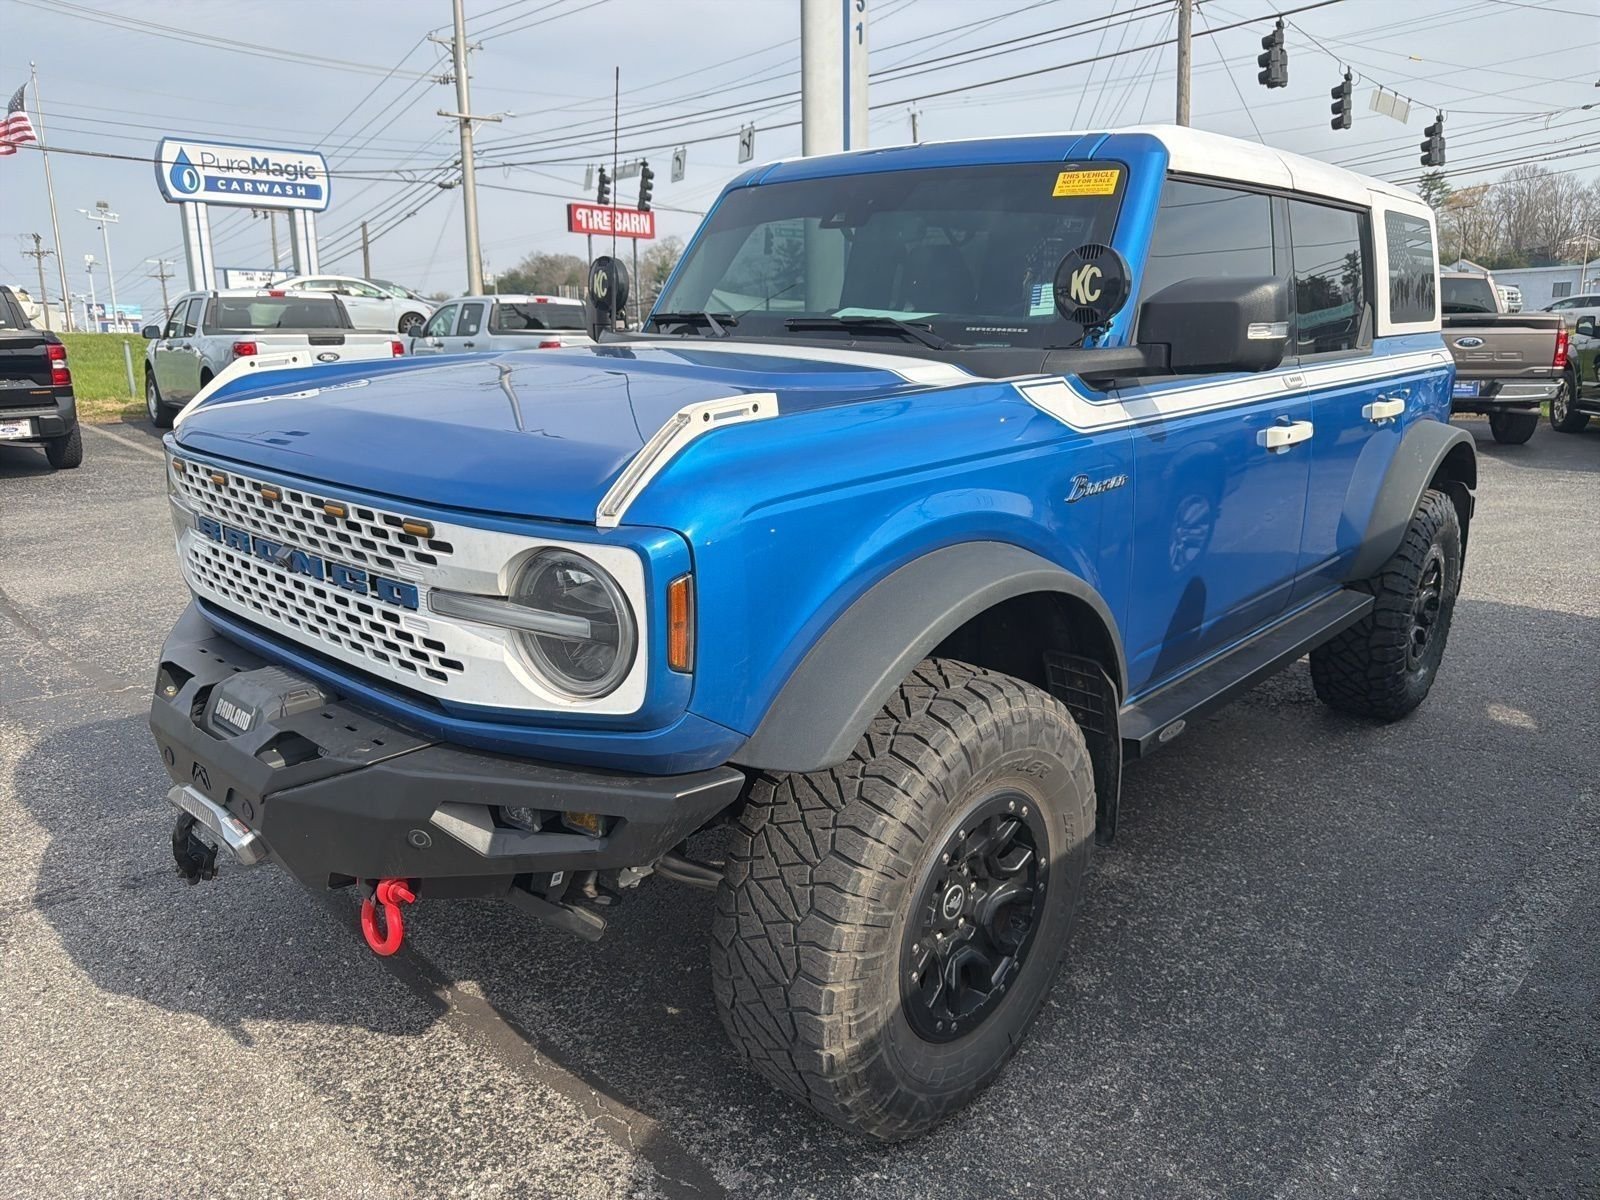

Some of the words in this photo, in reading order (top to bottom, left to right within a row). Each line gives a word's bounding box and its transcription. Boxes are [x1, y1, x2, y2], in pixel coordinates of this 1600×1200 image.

[217, 179, 306, 196] CARWASH
[1082, 171, 1115, 179] VEHICLE
[613, 211, 651, 234] BARN
[593, 269, 608, 299] KC
[1070, 263, 1103, 305] KC
[199, 515, 419, 612] BRONCO
[215, 697, 251, 731] BADLAND
